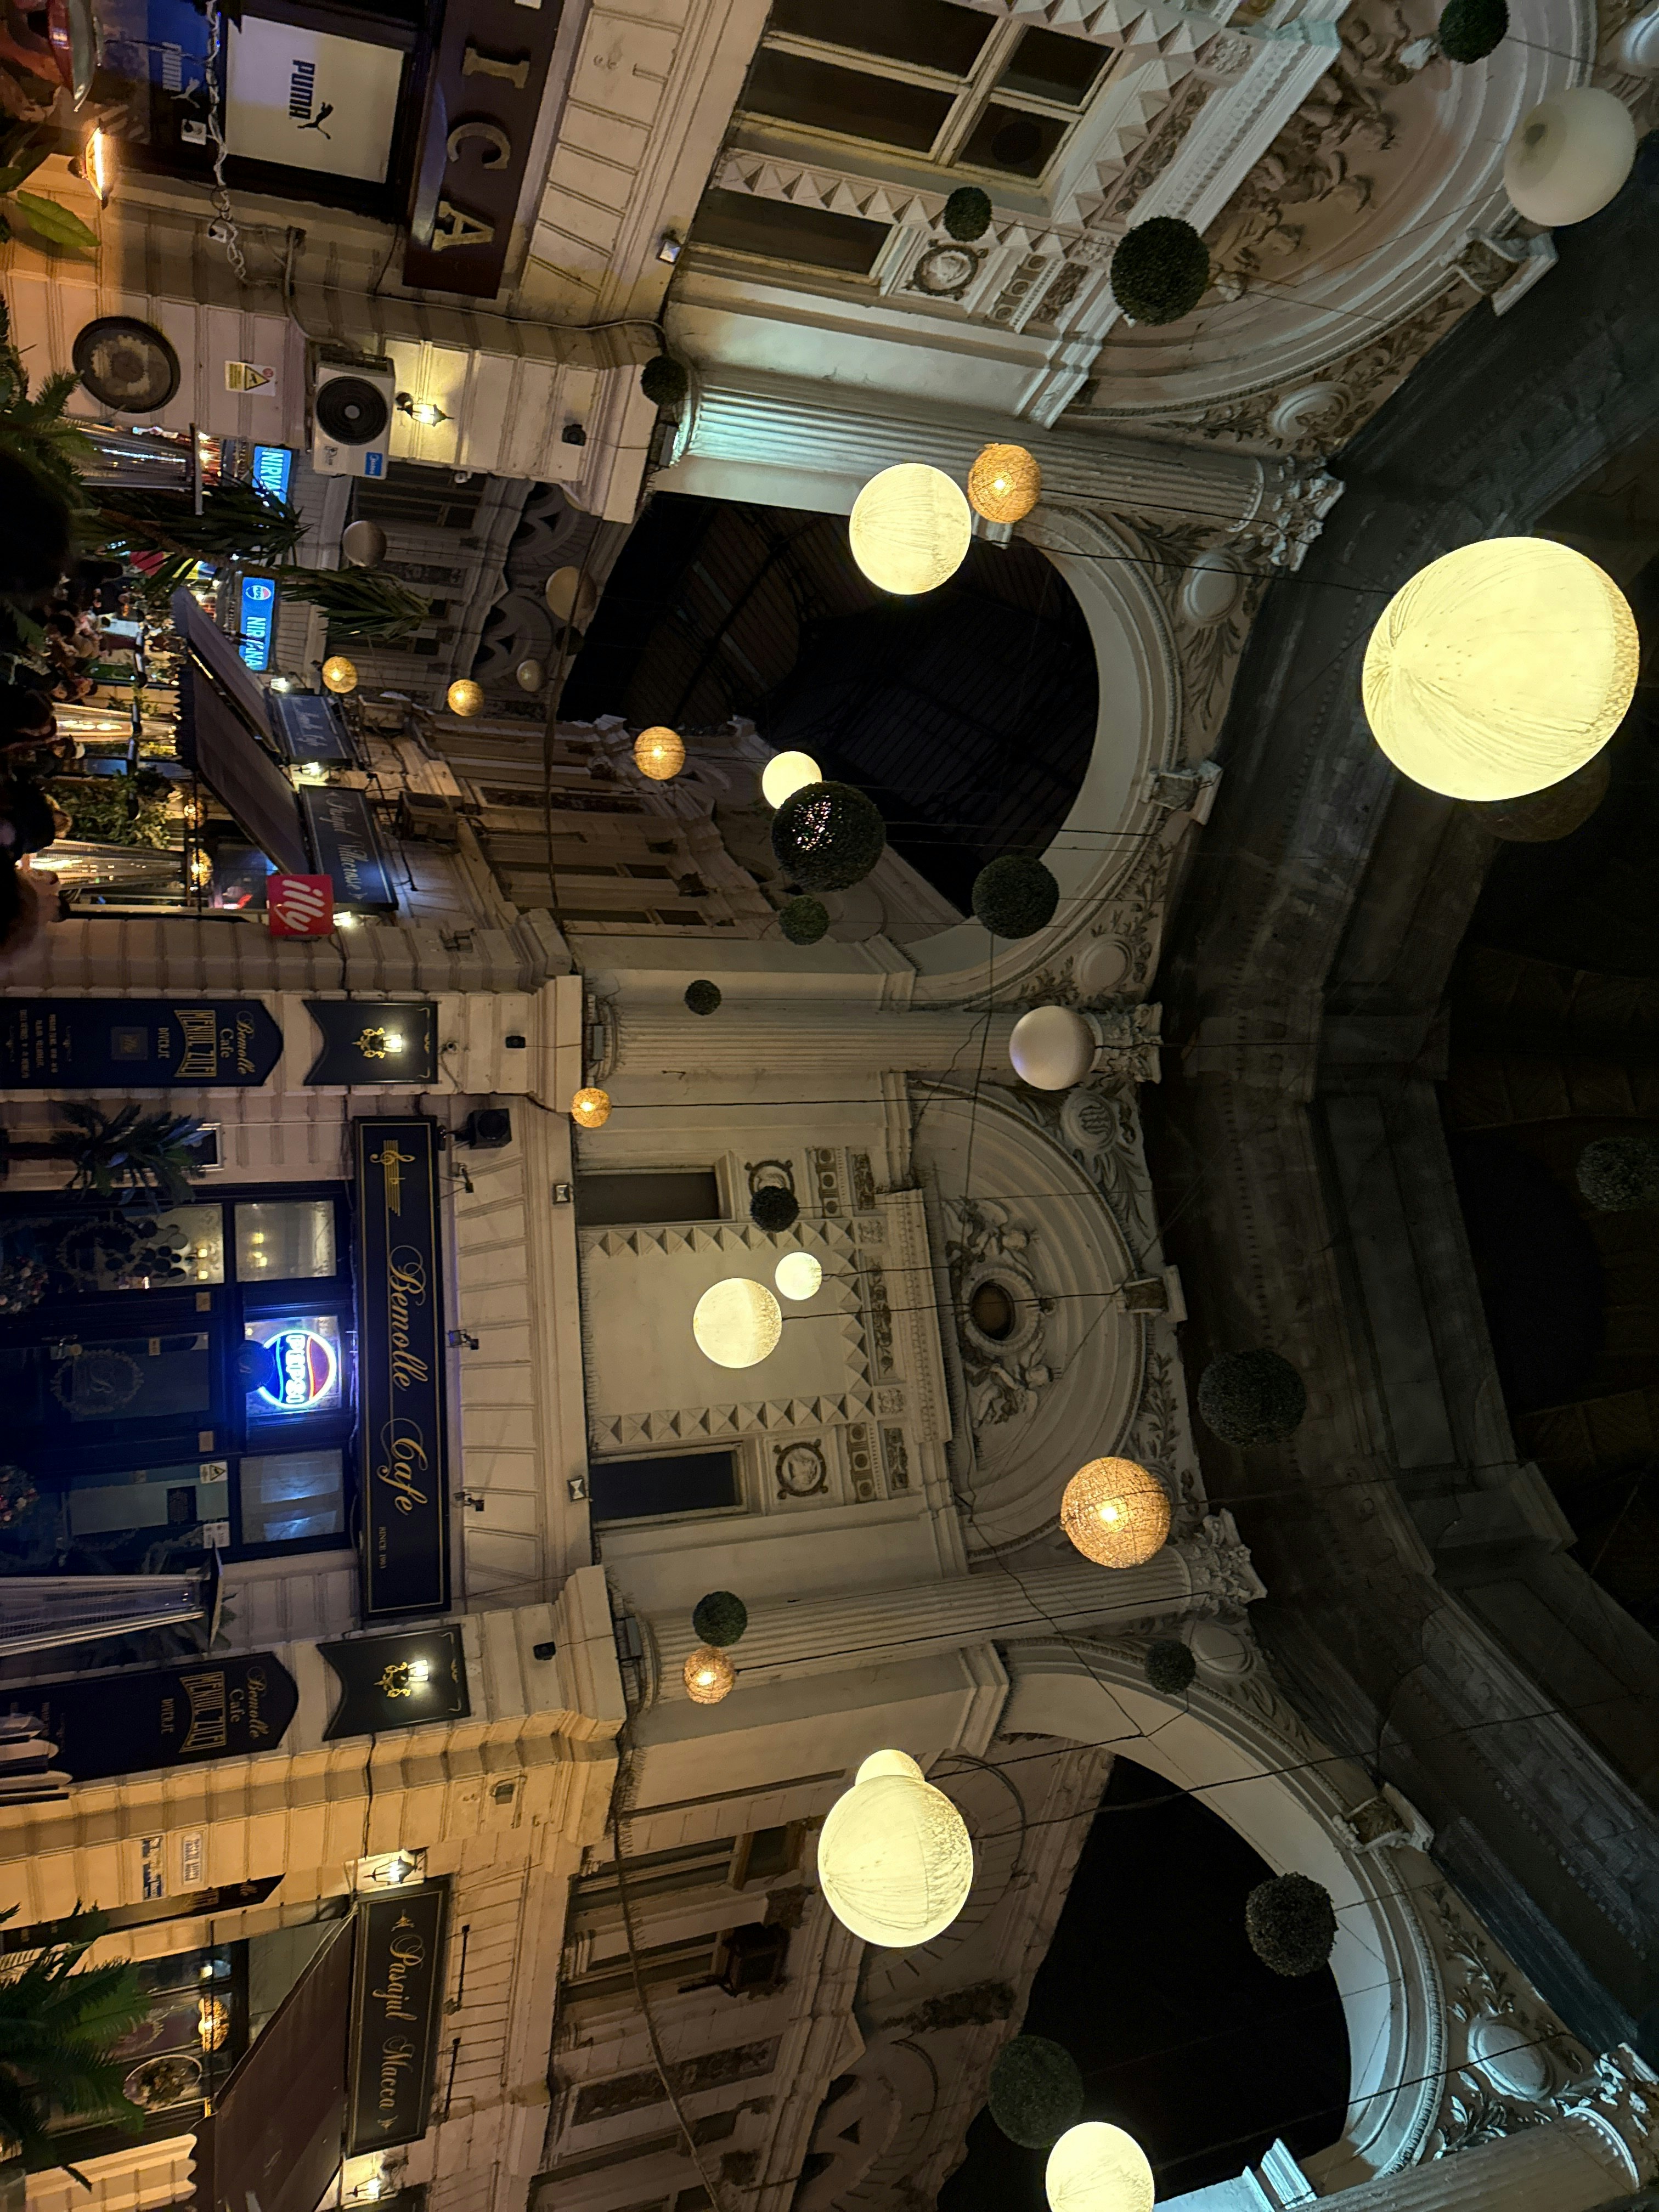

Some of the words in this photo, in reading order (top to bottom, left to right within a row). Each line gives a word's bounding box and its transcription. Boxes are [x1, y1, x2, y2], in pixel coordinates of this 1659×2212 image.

[289, 60, 315, 119] PUMA
[432, 0, 542, 252] ICA
[259, 451, 284, 507] NIRVA
[319, 799, 363, 837] Pasajul
[273, 879, 325, 932] illy
[219, 1028, 234, 1058] Cafe
[235, 1011, 255, 1076] Bemolle
[389, 1245, 429, 1391] Bemolle
[285, 1334, 306, 1403] PEPSI
[377, 1418, 429, 1516] Cafe
[229, 1688, 246, 1723] Cafe
[246, 1666, 269, 1740] Bemolle
[372, 1934, 426, 2021] Pasajul
[378, 2035, 416, 2109] Macca
